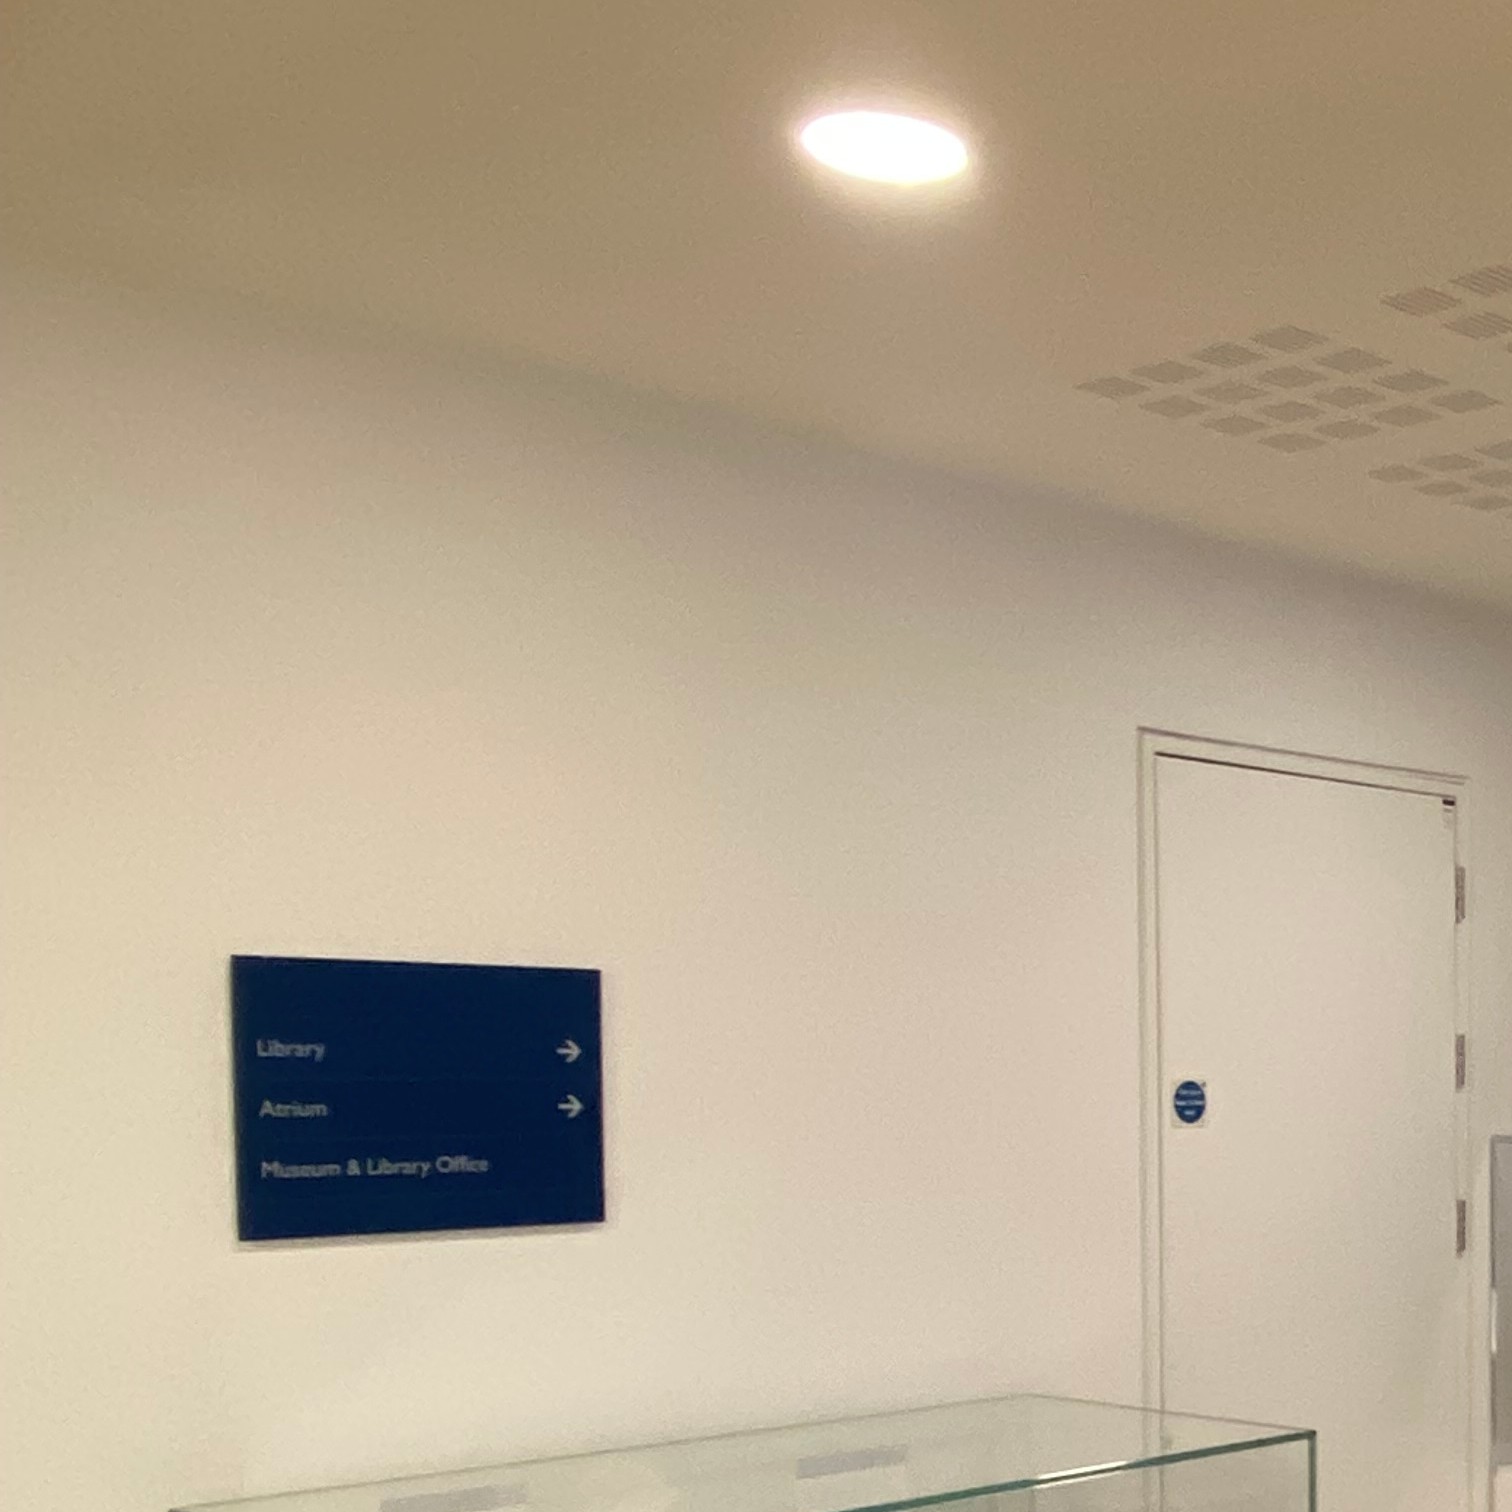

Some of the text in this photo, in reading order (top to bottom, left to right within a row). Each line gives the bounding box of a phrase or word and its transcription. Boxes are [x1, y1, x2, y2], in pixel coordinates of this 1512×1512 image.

[256, 1039, 325, 1062] Library
[259, 1099, 328, 1118] Atrium
[261, 1154, 489, 1179] Museum & Library Office
